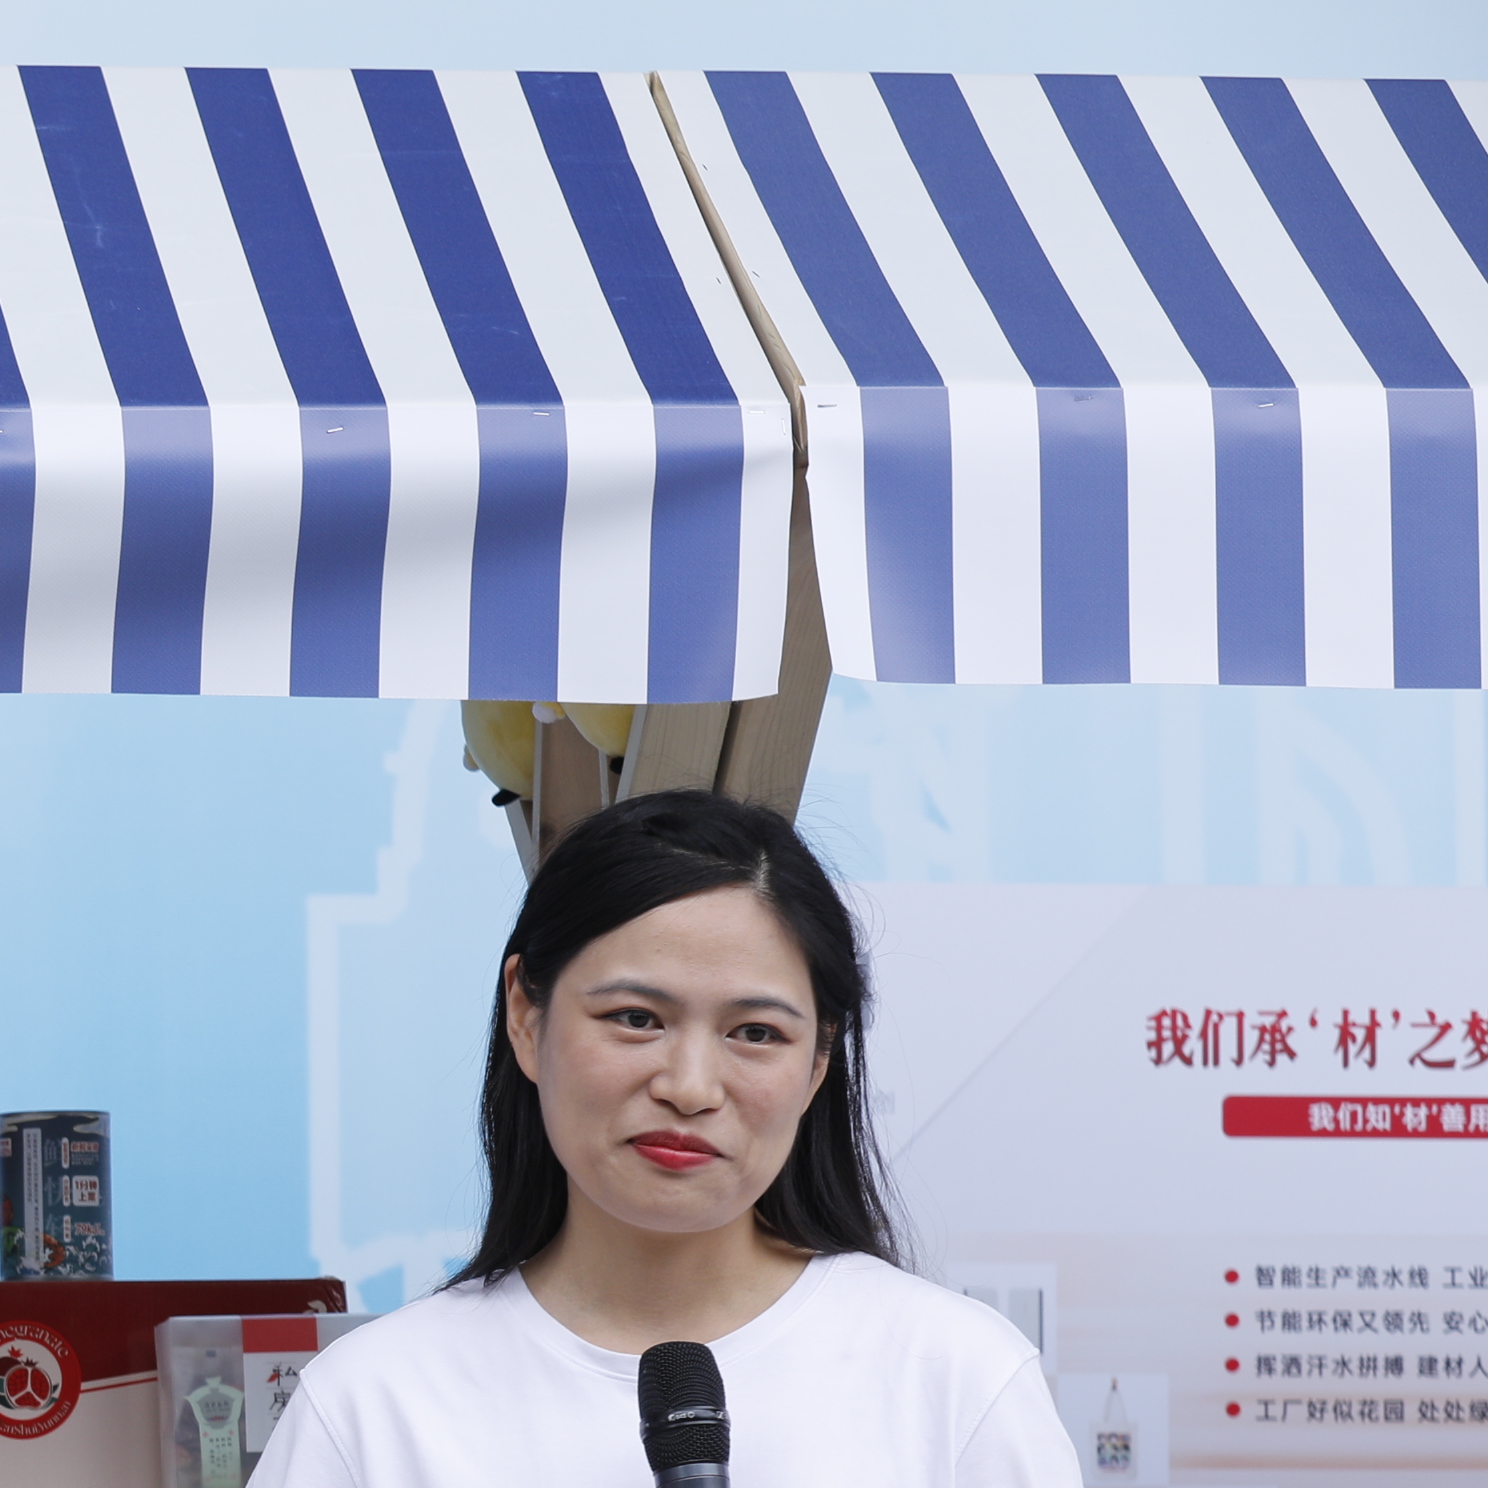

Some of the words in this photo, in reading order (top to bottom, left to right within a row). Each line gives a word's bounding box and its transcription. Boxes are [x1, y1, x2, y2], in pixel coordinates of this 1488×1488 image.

[1255, 1265, 1430, 1290] 智能生产流水线
[1444, 1266, 1488, 1289] 工业
[1255, 1309, 1431, 1334] 节能环保又领先
[1255, 1354, 1404, 1379] 挥洒汗水拼搏
[1255, 1399, 1404, 1424] 工厂好似花园
